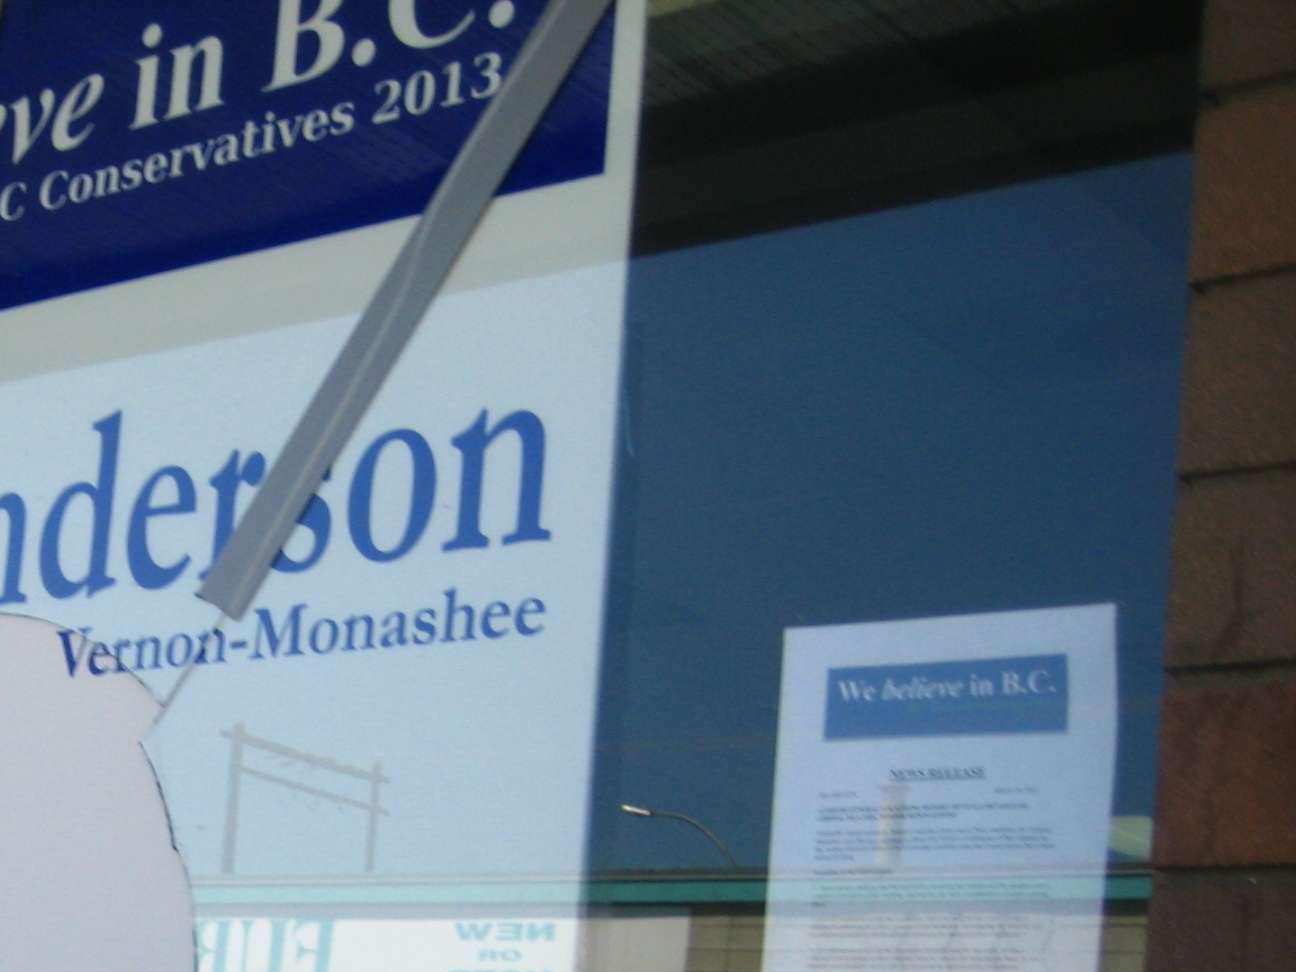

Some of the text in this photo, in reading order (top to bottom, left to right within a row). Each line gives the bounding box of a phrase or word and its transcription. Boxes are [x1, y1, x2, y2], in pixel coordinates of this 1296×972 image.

[129, 22, 225, 131] in
[39, 101, 355, 212] Conservatives
[371, 51, 503, 124] 2013
[57, 586, 547, 679] Vernon-Monashee
[838, 679, 877, 703] We
[969, 672, 994, 698] in
